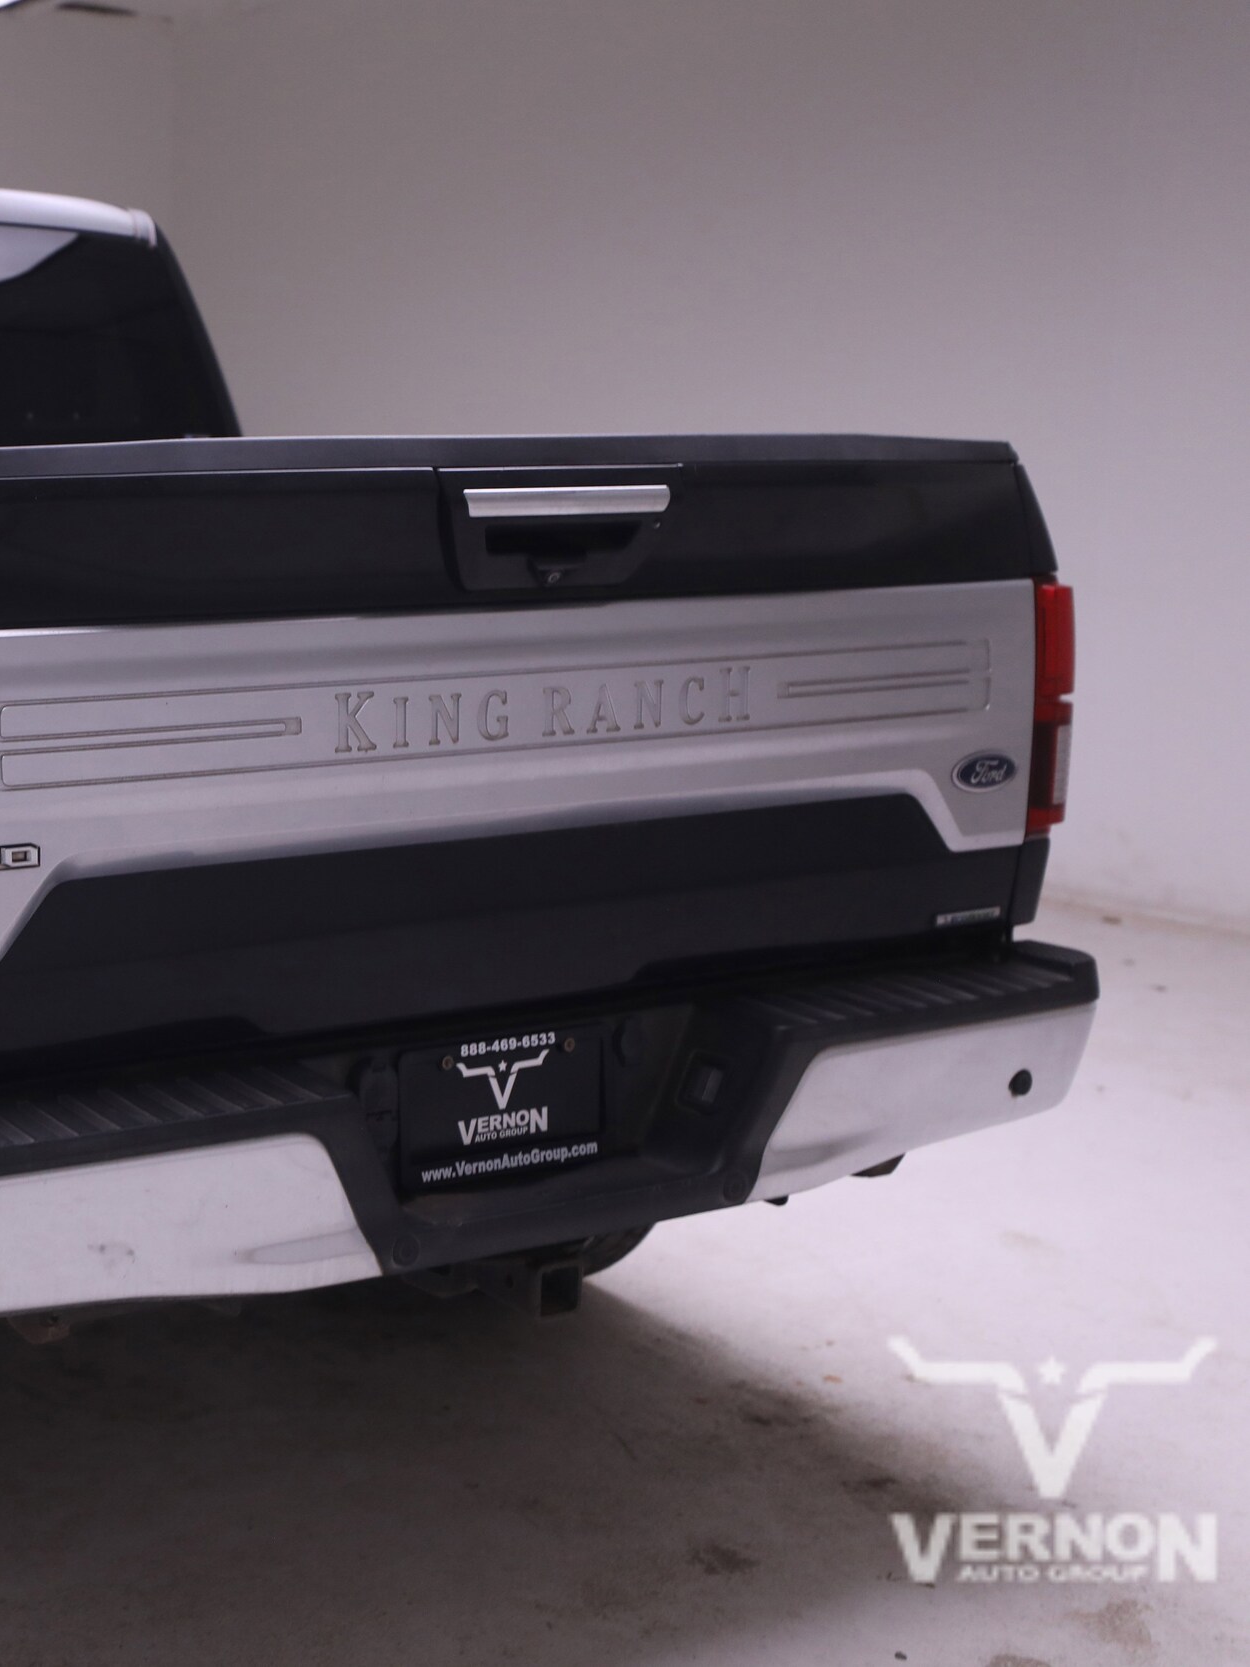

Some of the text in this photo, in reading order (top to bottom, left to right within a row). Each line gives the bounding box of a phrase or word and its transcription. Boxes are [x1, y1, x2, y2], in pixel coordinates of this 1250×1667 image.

[334, 666, 751, 753] KING RANCH
[970, 759, 1008, 784] Ford
[460, 1031, 556, 1057] 888-469-6533
[458, 1106, 548, 1146] VERNON
[475, 1126, 528, 1143] AUTO GROUP
[421, 1141, 598, 1183] www.VernonAutoGroup.com
